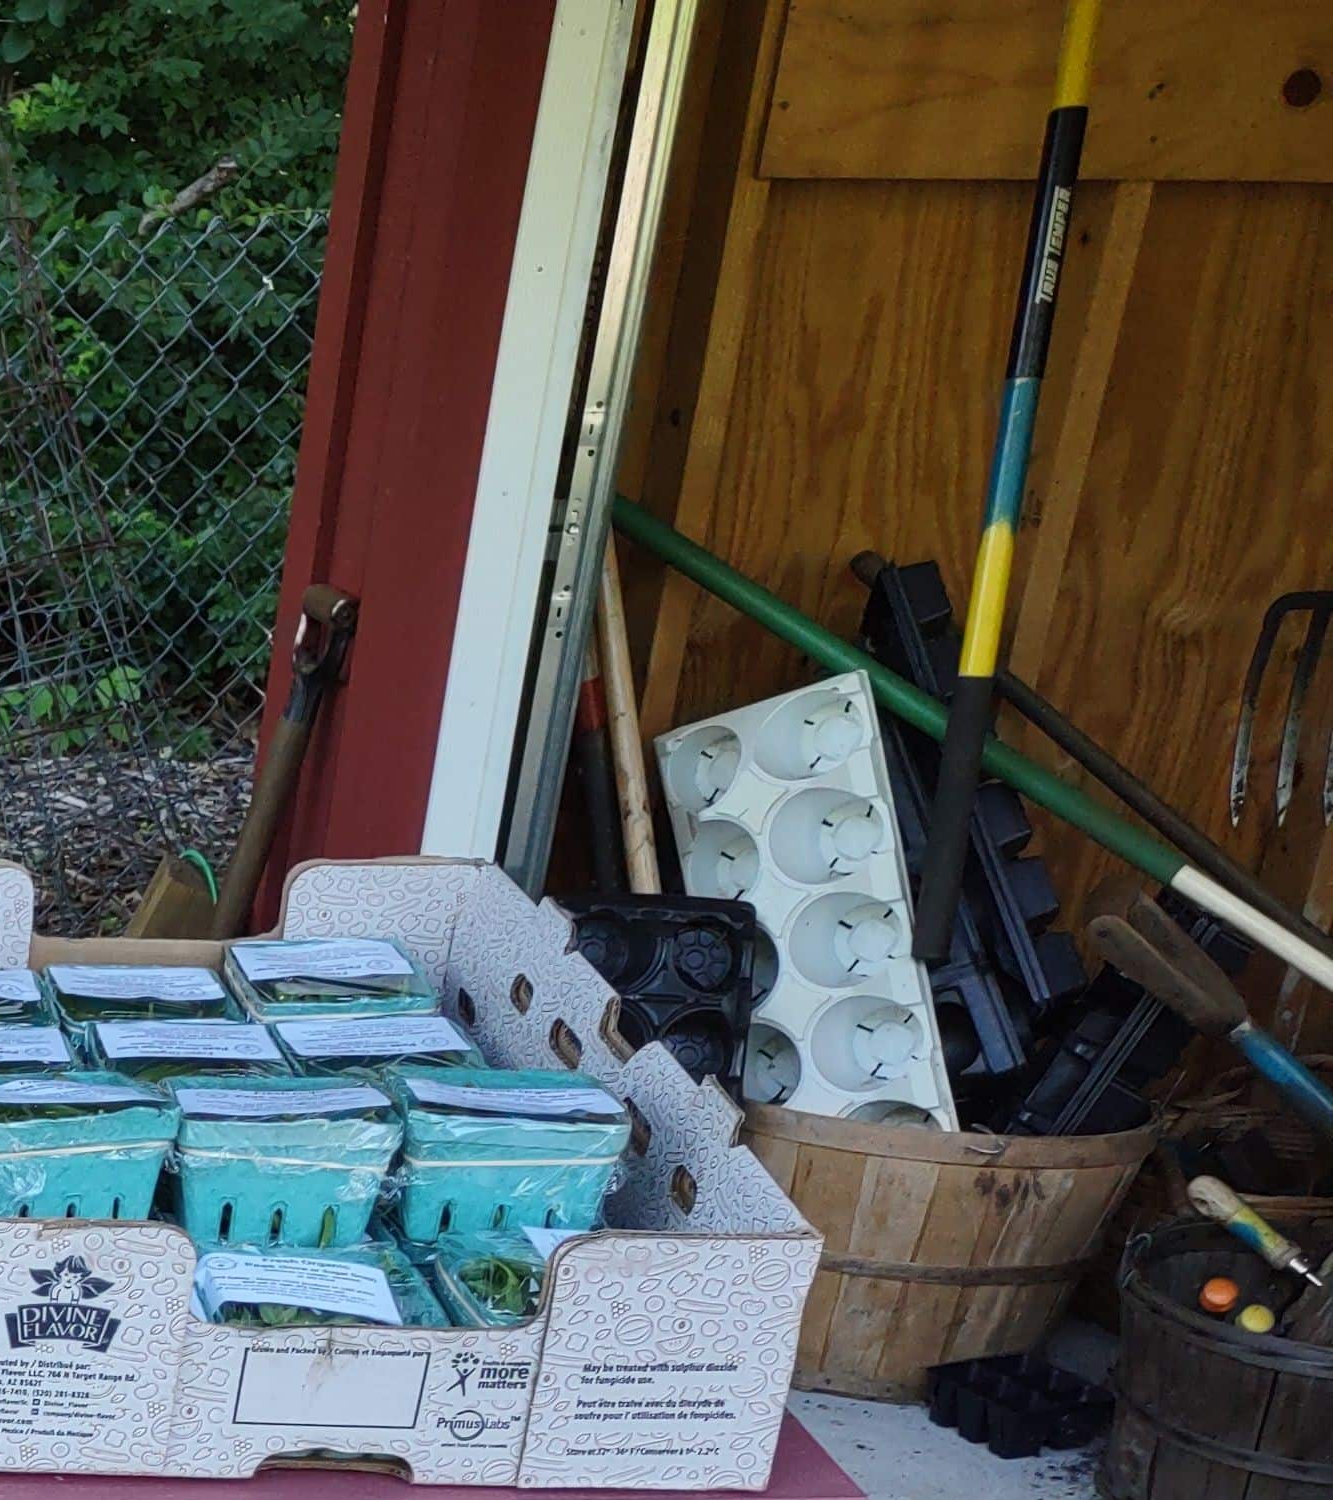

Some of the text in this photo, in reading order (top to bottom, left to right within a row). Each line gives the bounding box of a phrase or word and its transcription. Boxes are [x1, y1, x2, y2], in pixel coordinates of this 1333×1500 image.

[1035, 185, 1071, 304] TRUE TEMPER
[21, 1304, 101, 1326] DIVINE
[21, 1320, 98, 1343] FLAVOR
[20, 1359, 30, 1369] by
[583, 1363, 601, 1374] May
[602, 1363, 614, 1372] be
[615, 1364, 648, 1372] treated
[649, 1364, 670, 1372] with
[670, 1364, 705, 1374] sulphur
[0, 1368, 26, 1377] Flavor
[71, 1372, 96, 1382] Target
[480, 1367, 530, 1380] more
[477, 1380, 527, 1389] matters
[595, 1375, 636, 1386] fungicide
[602, 1412, 623, 1421] pour
[632, 1411, 675, 1420] utilisation
[677, 1411, 688, 1420] de
